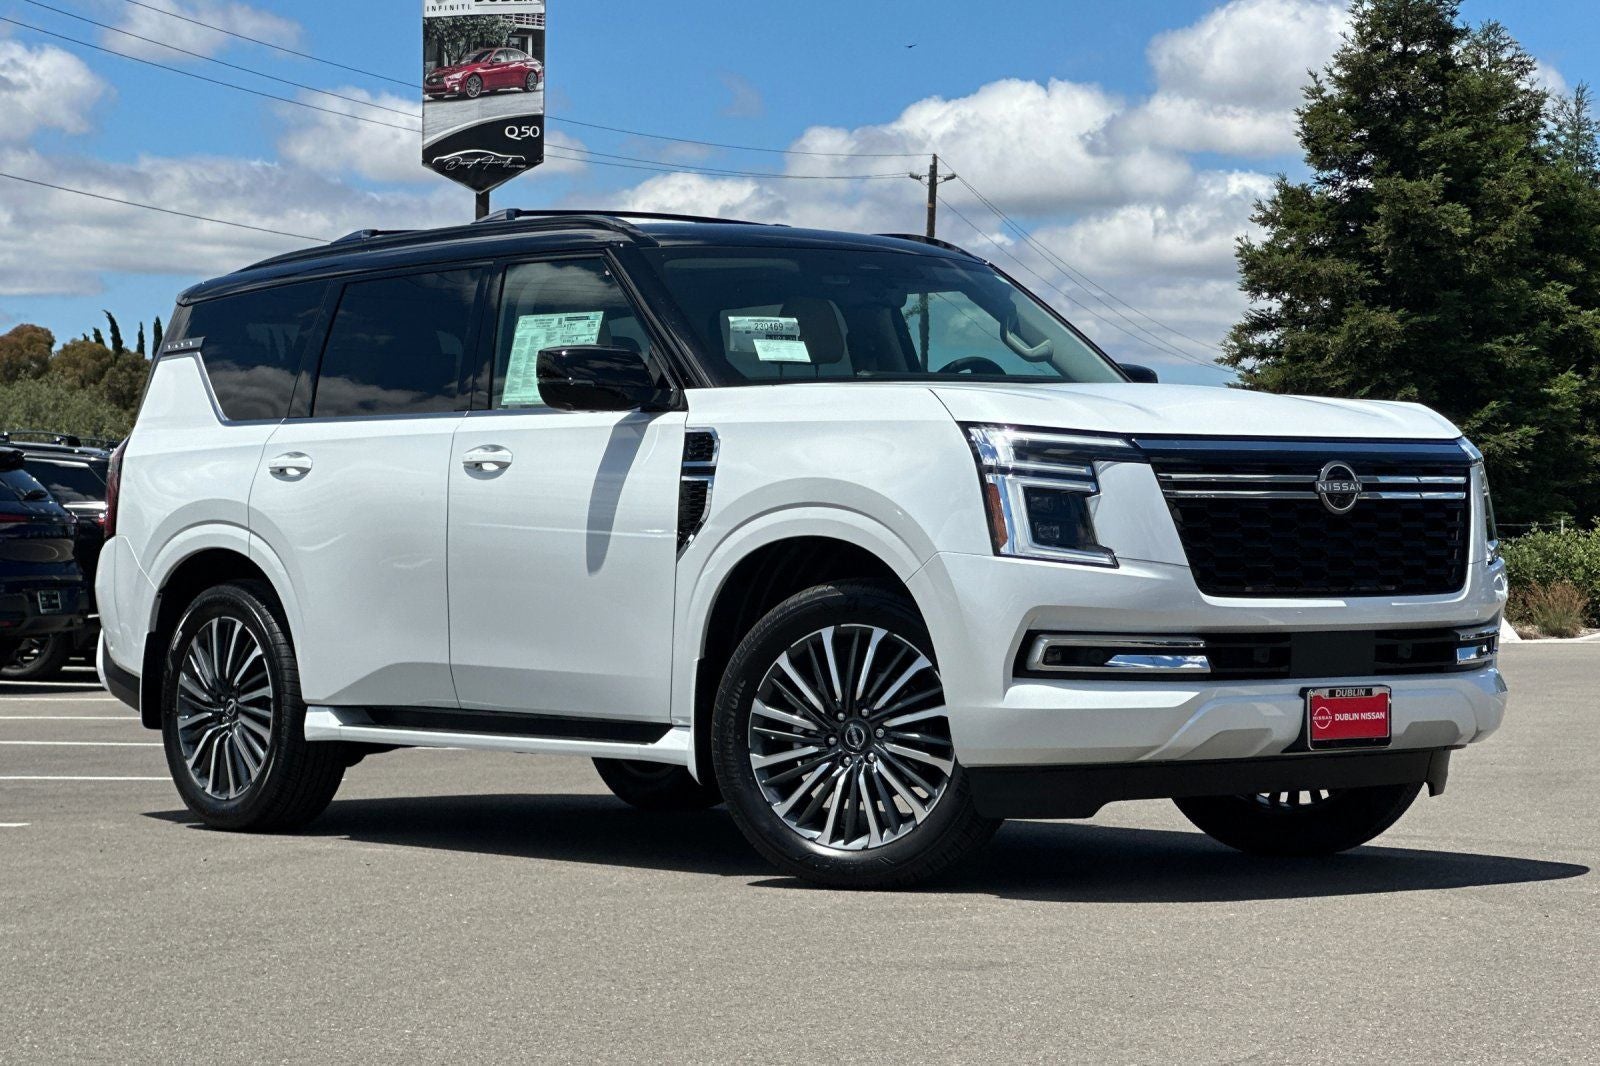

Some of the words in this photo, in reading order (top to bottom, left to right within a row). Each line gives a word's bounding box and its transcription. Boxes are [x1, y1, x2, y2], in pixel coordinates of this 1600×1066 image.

[426, 4, 471, 12] INFINITI
[505, 125, 540, 140] Q50
[755, 322, 785, 331] 230469
[1318, 482, 1362, 491] NISSAN
[1335, 689, 1366, 697] DUBLIN
[1335, 713, 1359, 721] DUBLIN
[1360, 711, 1385, 720] NISSAN
